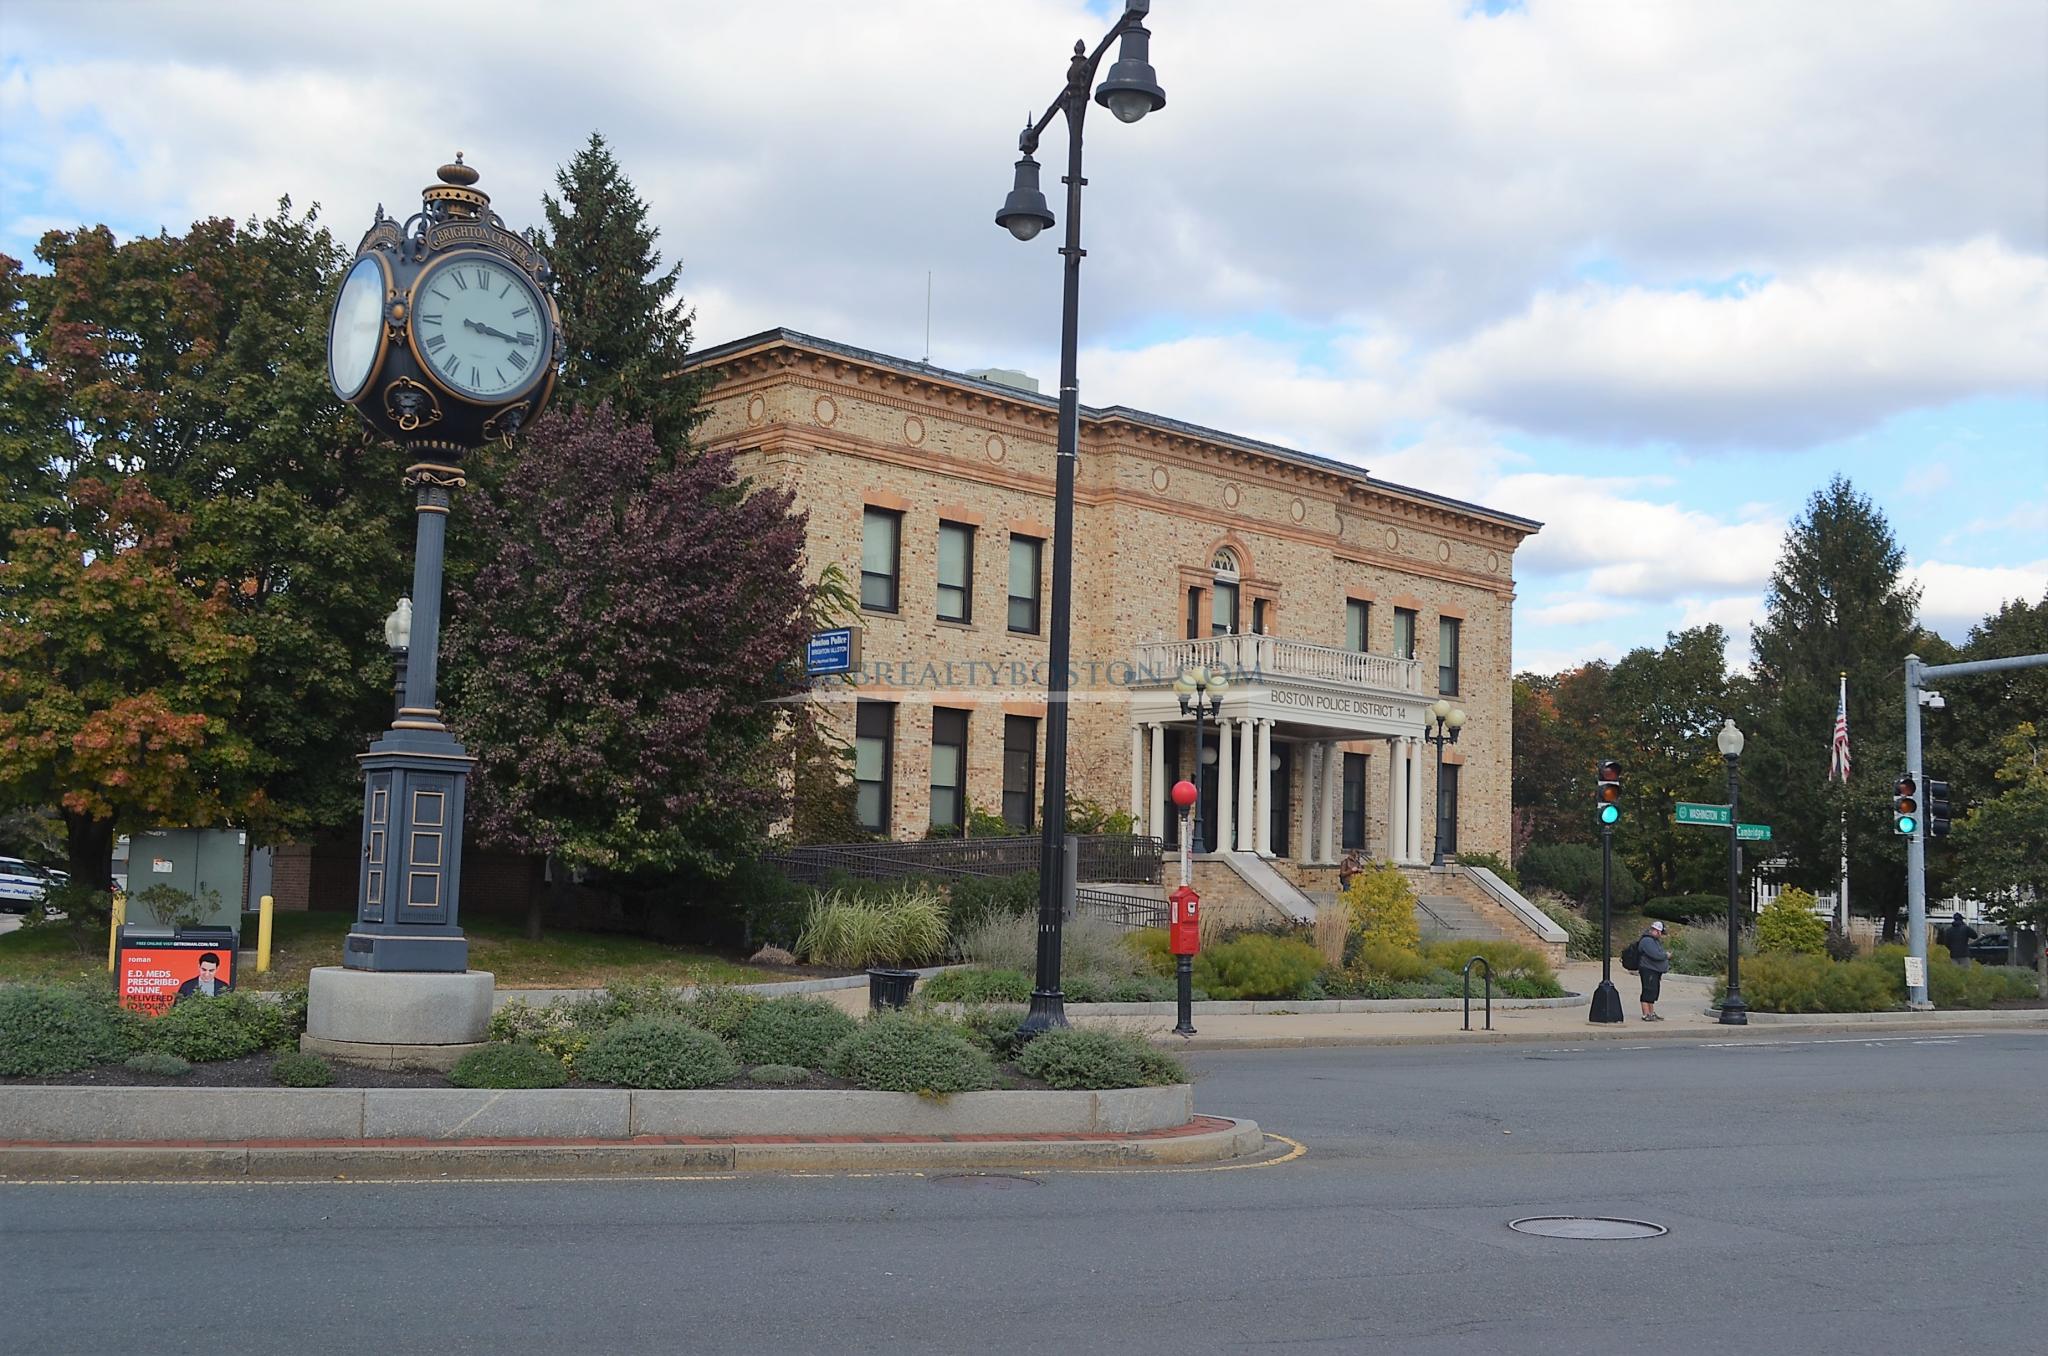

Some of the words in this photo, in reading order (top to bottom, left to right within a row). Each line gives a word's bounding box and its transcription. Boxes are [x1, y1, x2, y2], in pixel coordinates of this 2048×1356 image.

[436, 225, 489, 242] BRIGHTON
[491, 231, 529, 260] CENTER
[830, 635, 847, 645] Police
[1270, 689, 1314, 708] BOSTON
[1316, 696, 1350, 713] POLICE
[1353, 701, 1394, 718] DISTRICT
[1396, 707, 1406, 719] 14
[1689, 808, 1718, 821] WASHINGTON
[1720, 811, 1727, 821] ST
[1736, 826, 1764, 837] Cambridge
[127, 970, 144, 978] E.D.
[146, 970, 172, 978] MEDS
[127, 978, 180, 986] PRESCRIBED
[126, 986, 163, 995] ONLINE,
